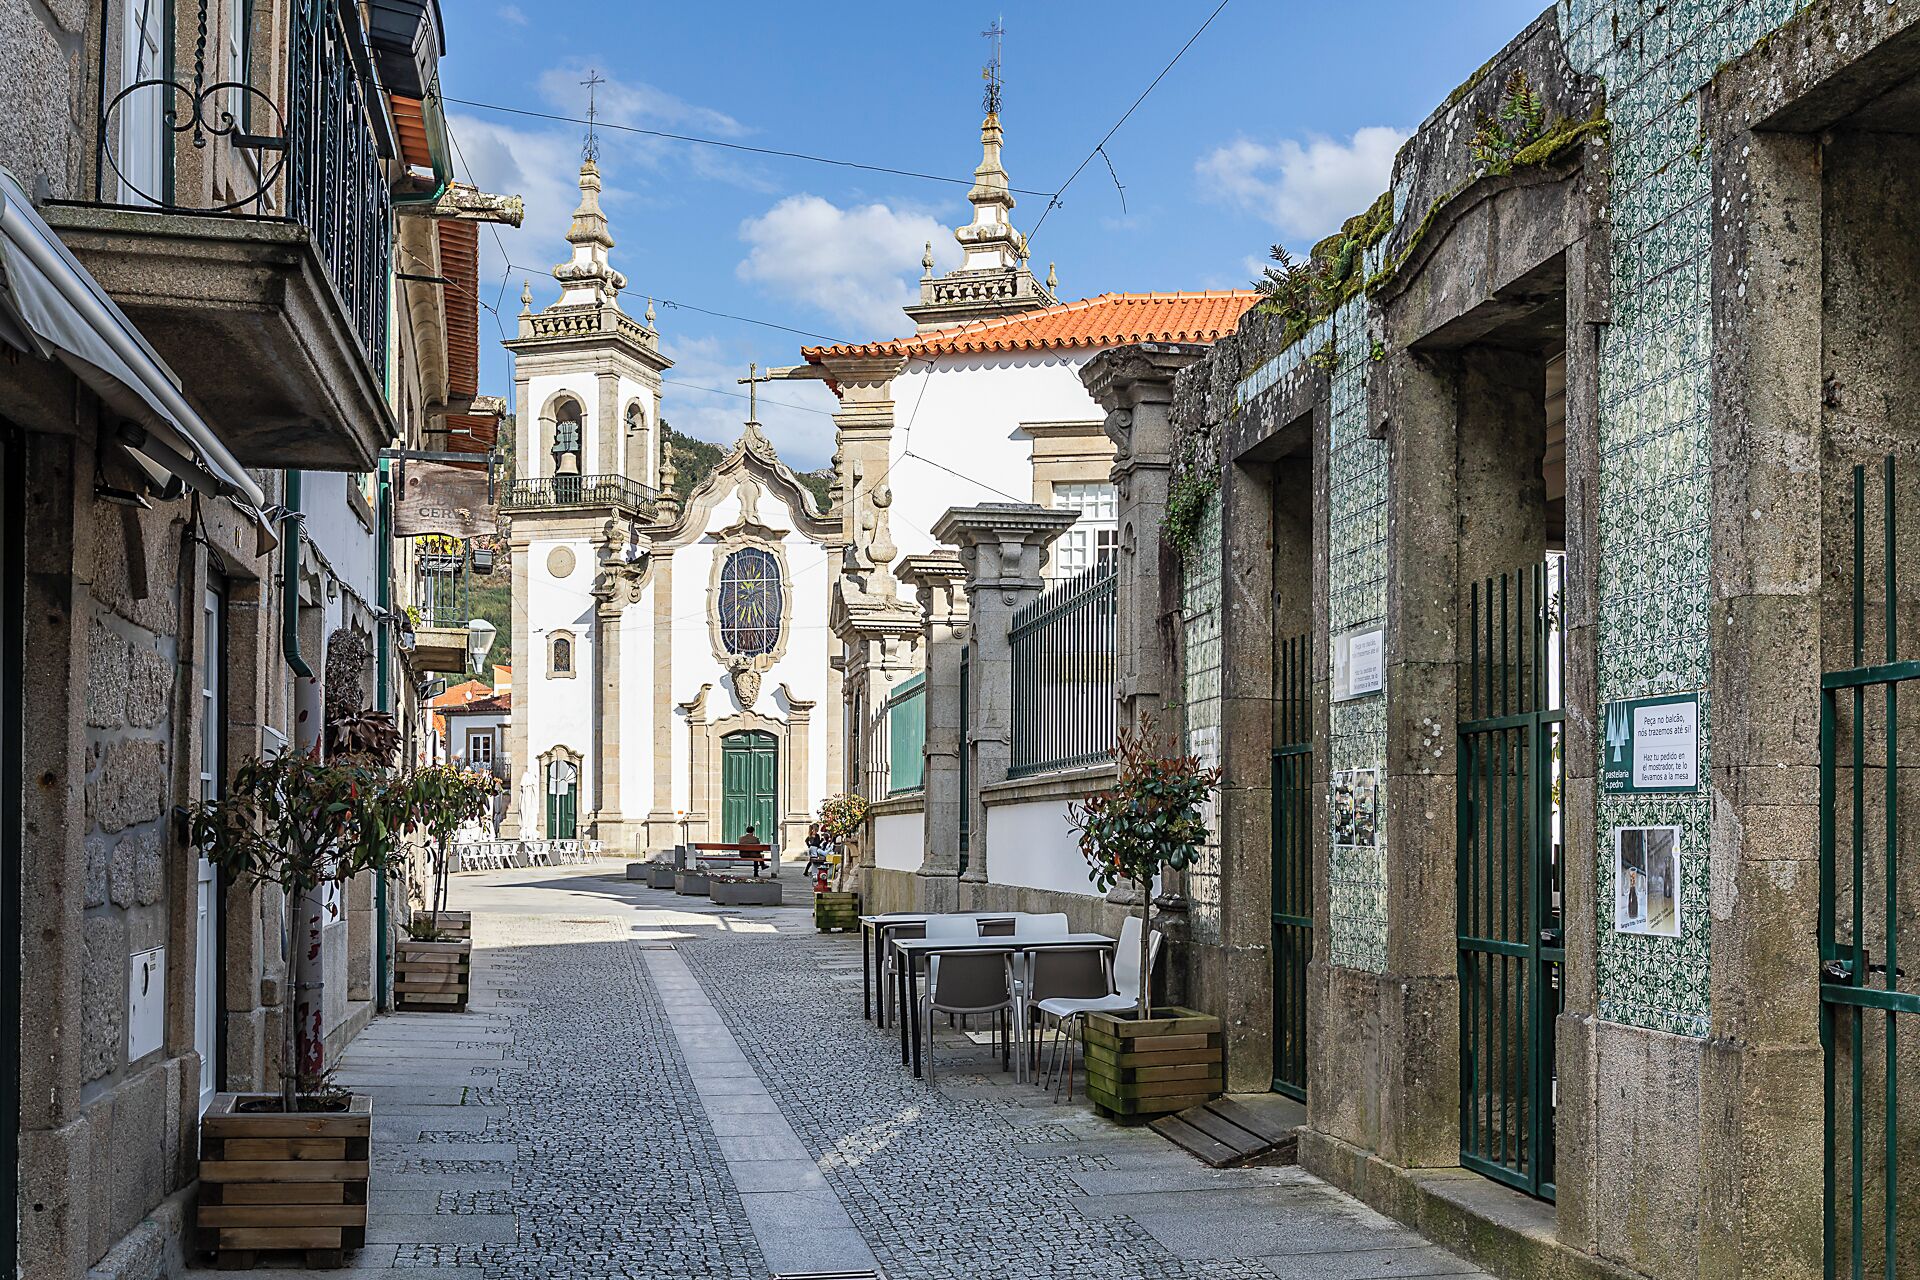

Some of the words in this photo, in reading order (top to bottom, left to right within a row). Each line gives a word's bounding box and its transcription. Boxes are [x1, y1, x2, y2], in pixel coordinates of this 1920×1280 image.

[1643, 717, 1657, 727] Peça
[1665, 713, 1685, 723] balcão,
[1637, 728, 1648, 737] nós
[1648, 726, 1673, 736] trazemos
[1674, 724, 1684, 734] até
[1643, 753, 1653, 762] Haz
[1653, 753, 1660, 761] tu
[1660, 751, 1678, 762] pedido
[1678, 752, 1686, 760] en
[1642, 762, 1648, 771] el
[1648, 761, 1675, 771] mostrador,
[1675, 762, 1682, 770] te
[1682, 761, 1688, 770] lo
[1605, 769, 1630, 780] pastelaria
[1641, 772, 1664, 781] llevamos
[1668, 772, 1674, 780] la
[1674, 772, 1689, 780] mesa
[1605, 779, 1624, 790] s.pedro
